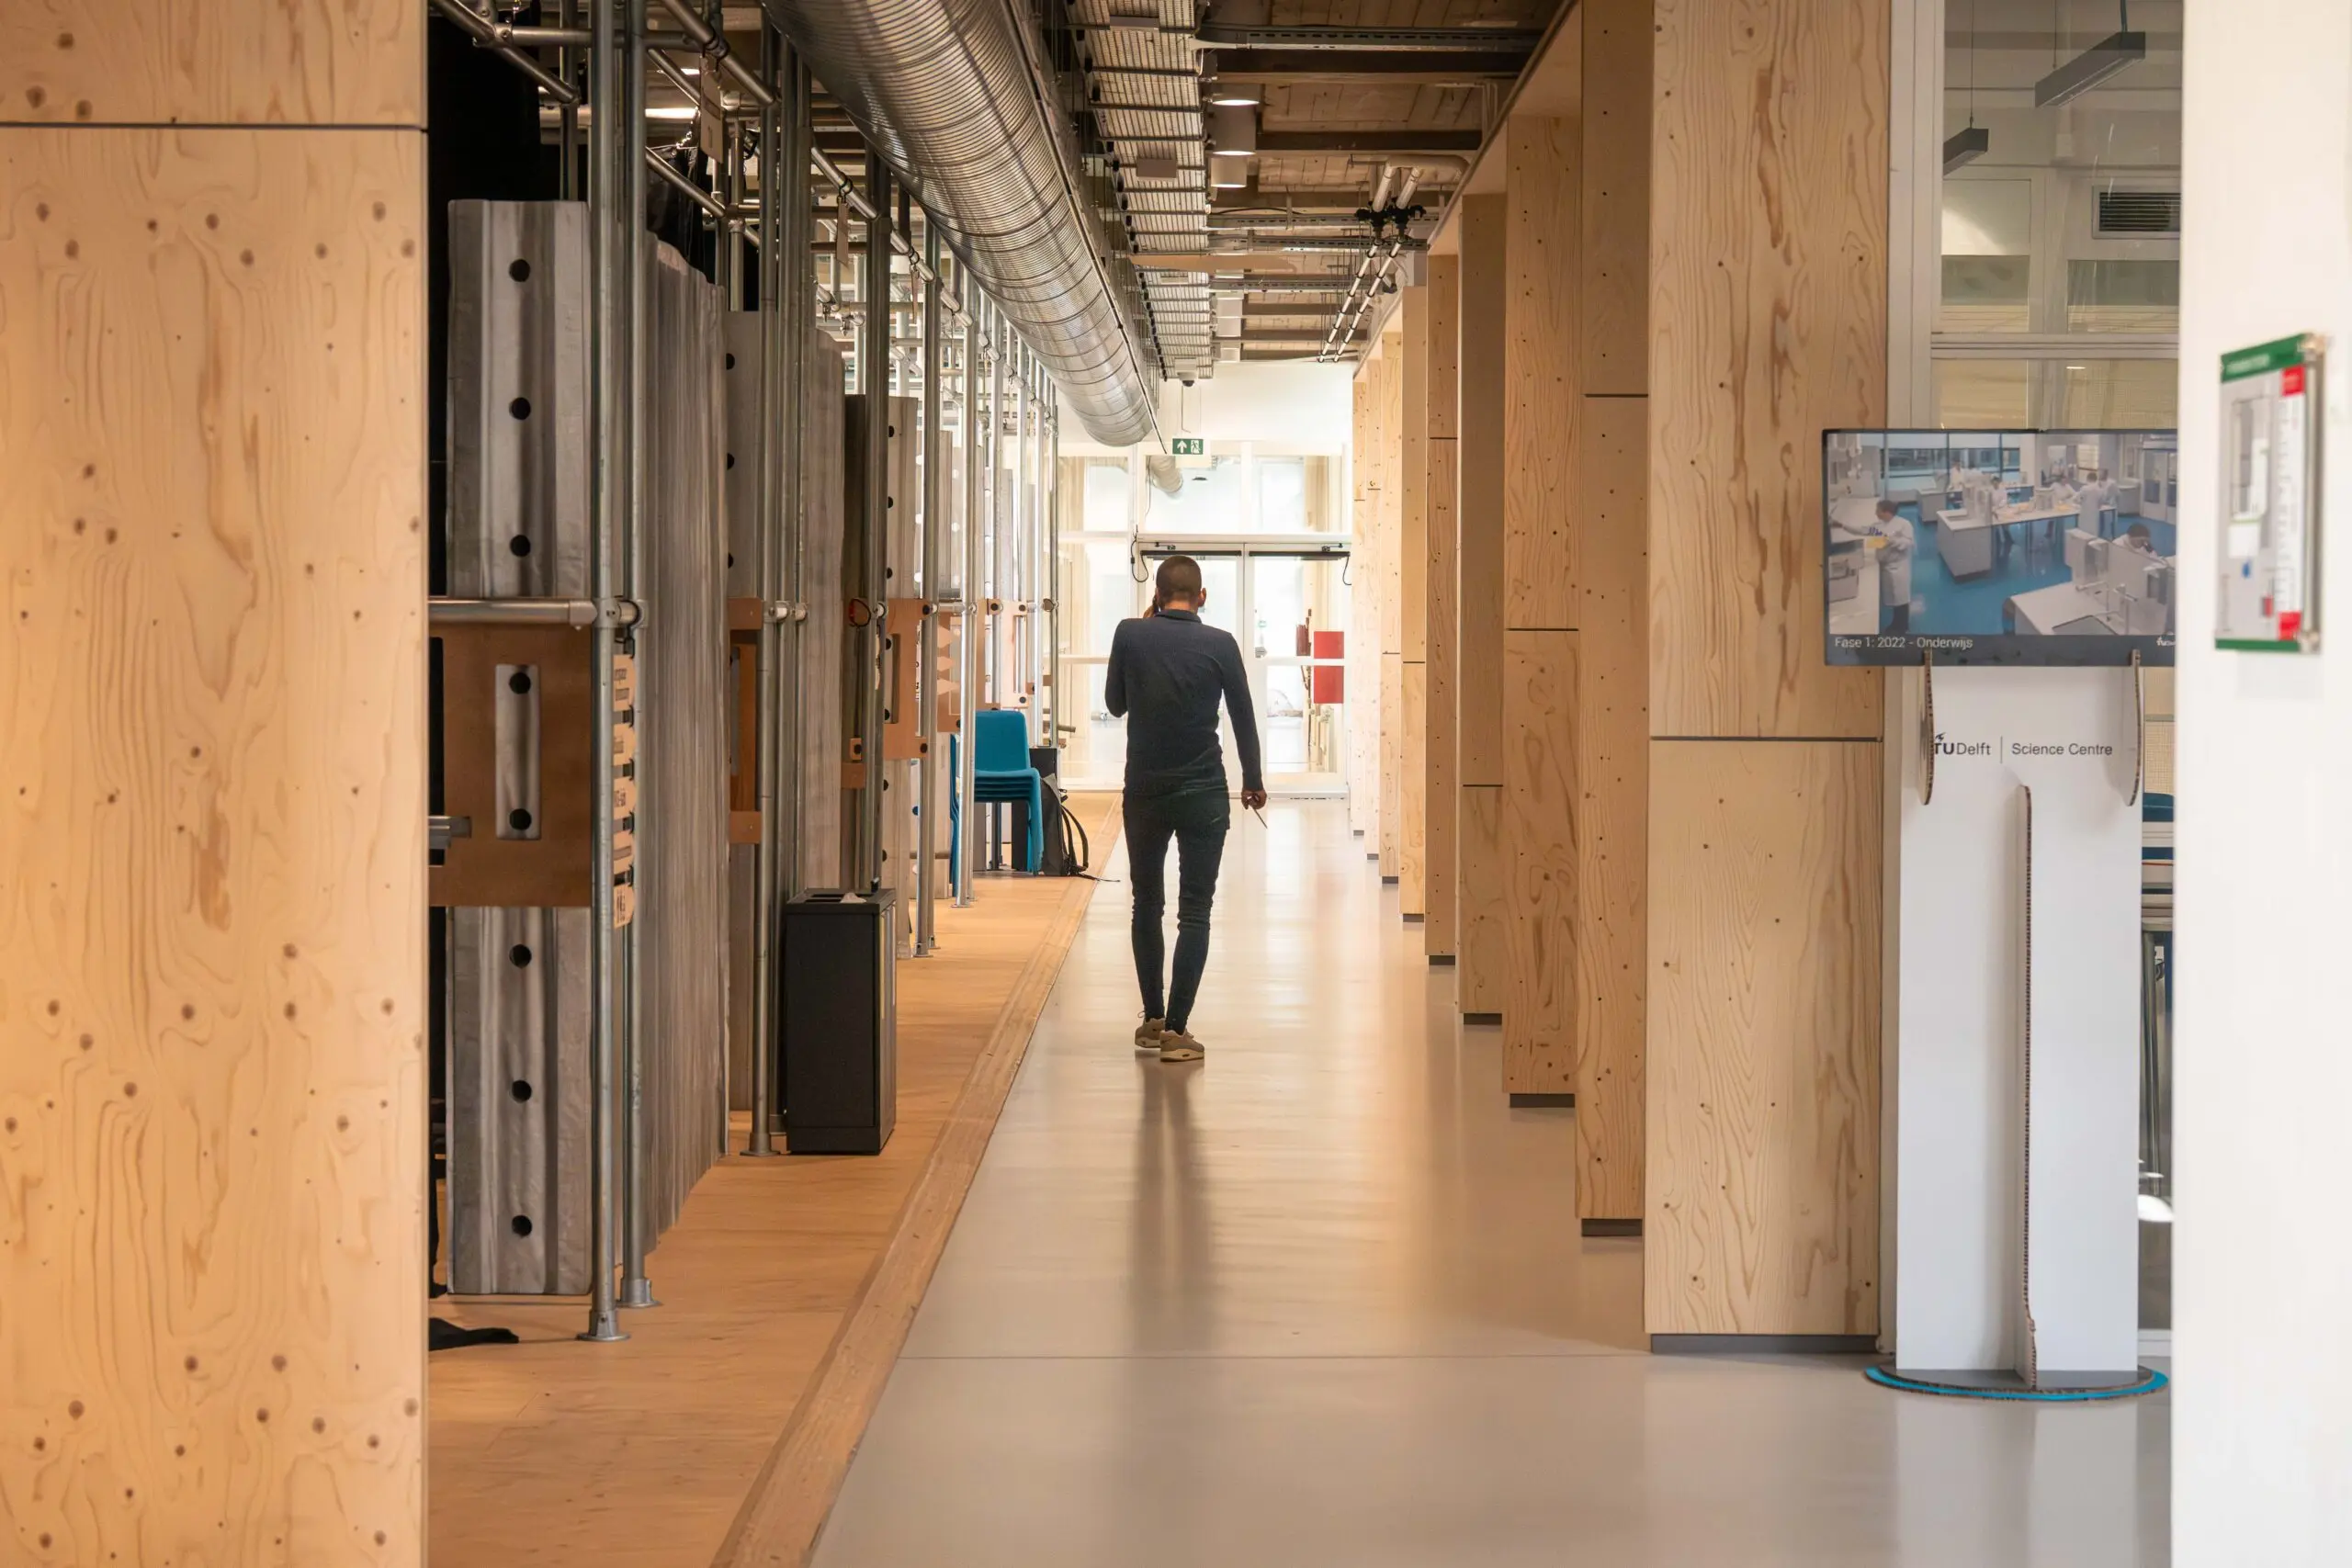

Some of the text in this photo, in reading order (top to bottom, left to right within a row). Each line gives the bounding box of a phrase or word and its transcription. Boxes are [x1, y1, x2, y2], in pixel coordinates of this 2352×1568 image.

[1834, 637, 1861, 649] Fase
[1865, 637, 1875, 649] 1:
[1877, 637, 1905, 649] 2022
[1917, 637, 1973, 650] Onderwijs
[2011, 742, 2064, 755] Science
[2068, 742, 2113, 755] Centre
